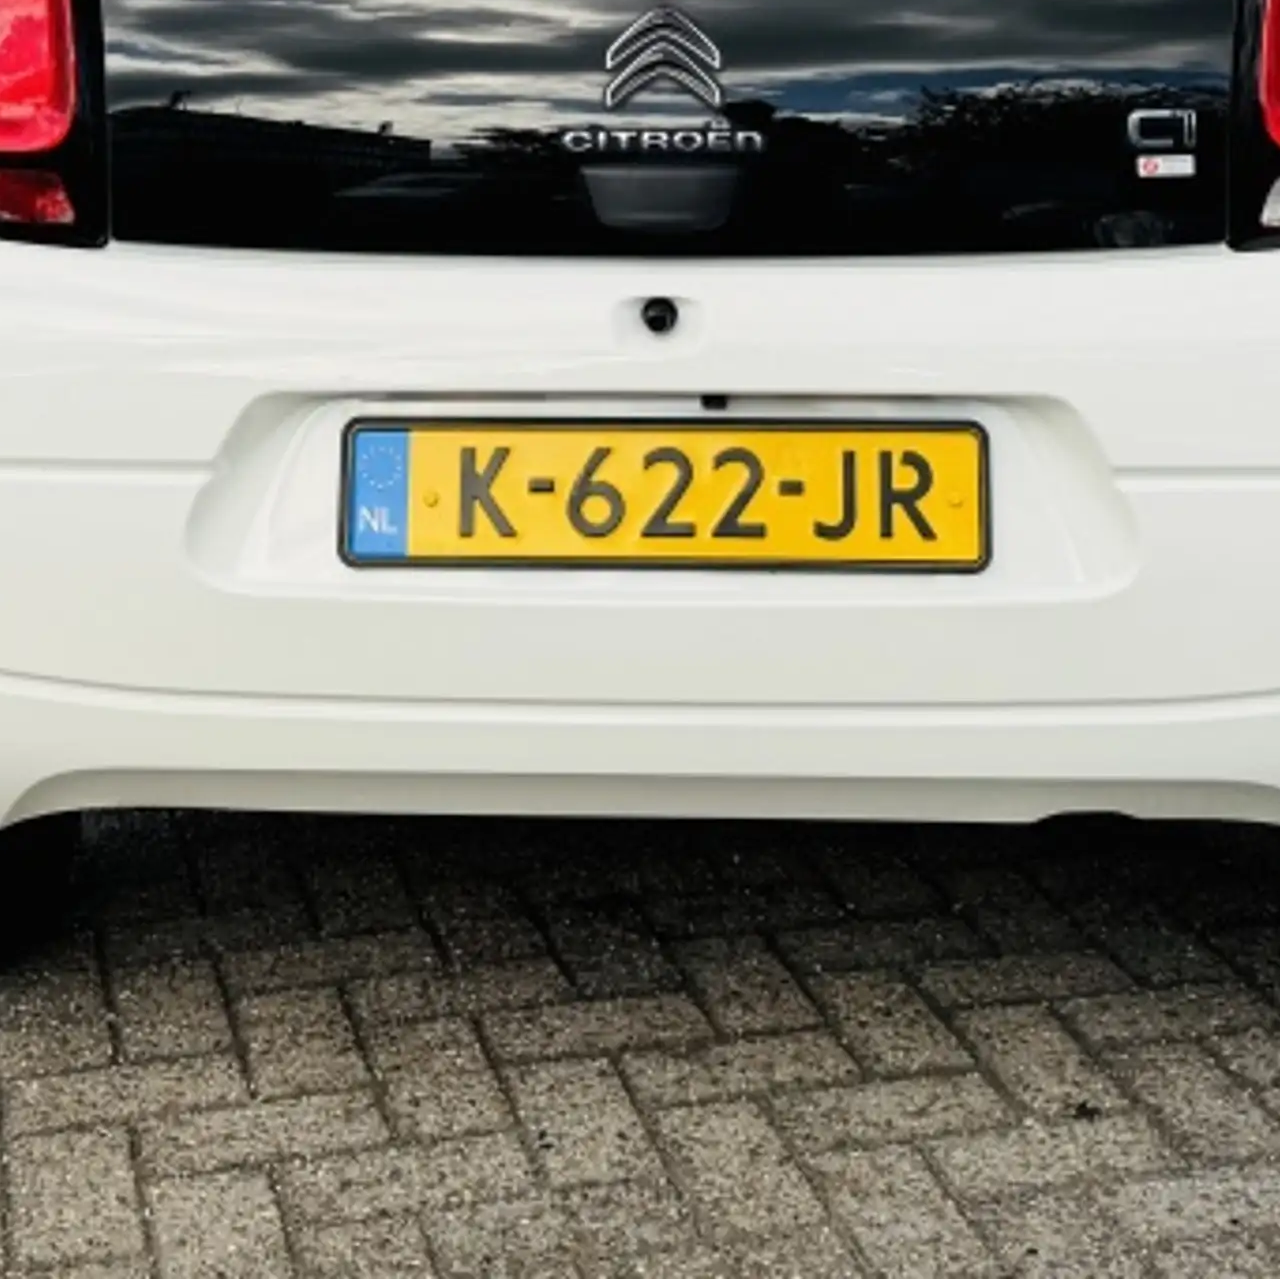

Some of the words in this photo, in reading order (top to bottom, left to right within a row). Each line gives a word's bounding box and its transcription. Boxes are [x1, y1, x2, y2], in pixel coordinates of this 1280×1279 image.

[1127, 108, 1197, 149] C1
[456, 446, 938, 541] K-622-JR
[358, 505, 399, 535] NL
